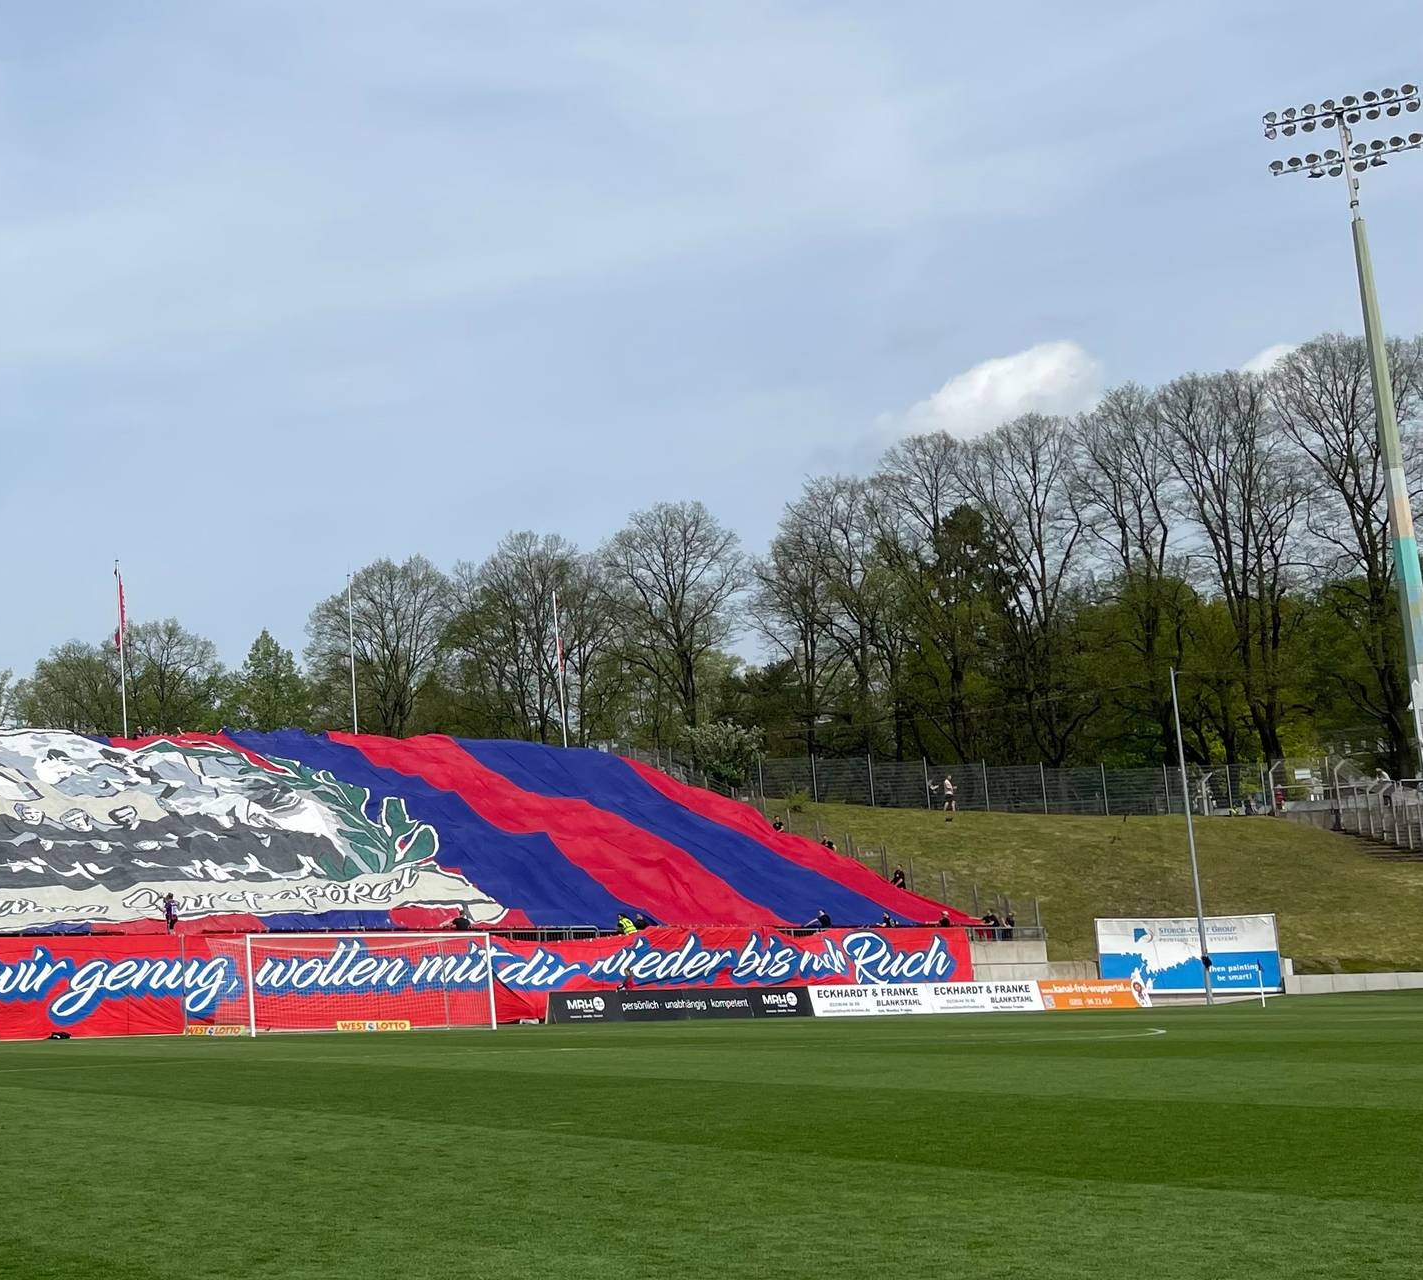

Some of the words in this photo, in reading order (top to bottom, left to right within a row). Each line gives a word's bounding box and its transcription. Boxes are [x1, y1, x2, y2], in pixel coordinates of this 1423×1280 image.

[1228, 964, 1259, 973] painting
[50, 957, 239, 1017] genug,
[256, 940, 409, 987] wollen
[411, 943, 514, 985] mit
[496, 948, 580, 985] dir
[587, 935, 732, 980] wieder
[732, 934, 798, 978] bis
[842, 931, 951, 985] Ruch
[1228, 973, 1252, 981] smart!
[817, 988, 868, 998] ECKHARDT
[872, 988, 878, 997] &
[881, 987, 918, 996] FRANKE
[934, 986, 983, 995] ECKHARDT
[986, 985, 992, 994] &
[995, 984, 1031, 993] FRANKE
[622, 1000, 659, 1011] persönlich
[665, 999, 707, 1011] unabhängig
[710, 998, 749, 1009] kompetent
[762, 994, 787, 1005] MRH
[877, 999, 922, 1007] BLANKSTAHL
[566, 1000, 594, 1010] MRH
[215, 1026, 241, 1034] LOTTO
[340, 1022, 366, 1030] WEST
[376, 1022, 407, 1030] LOTTO
